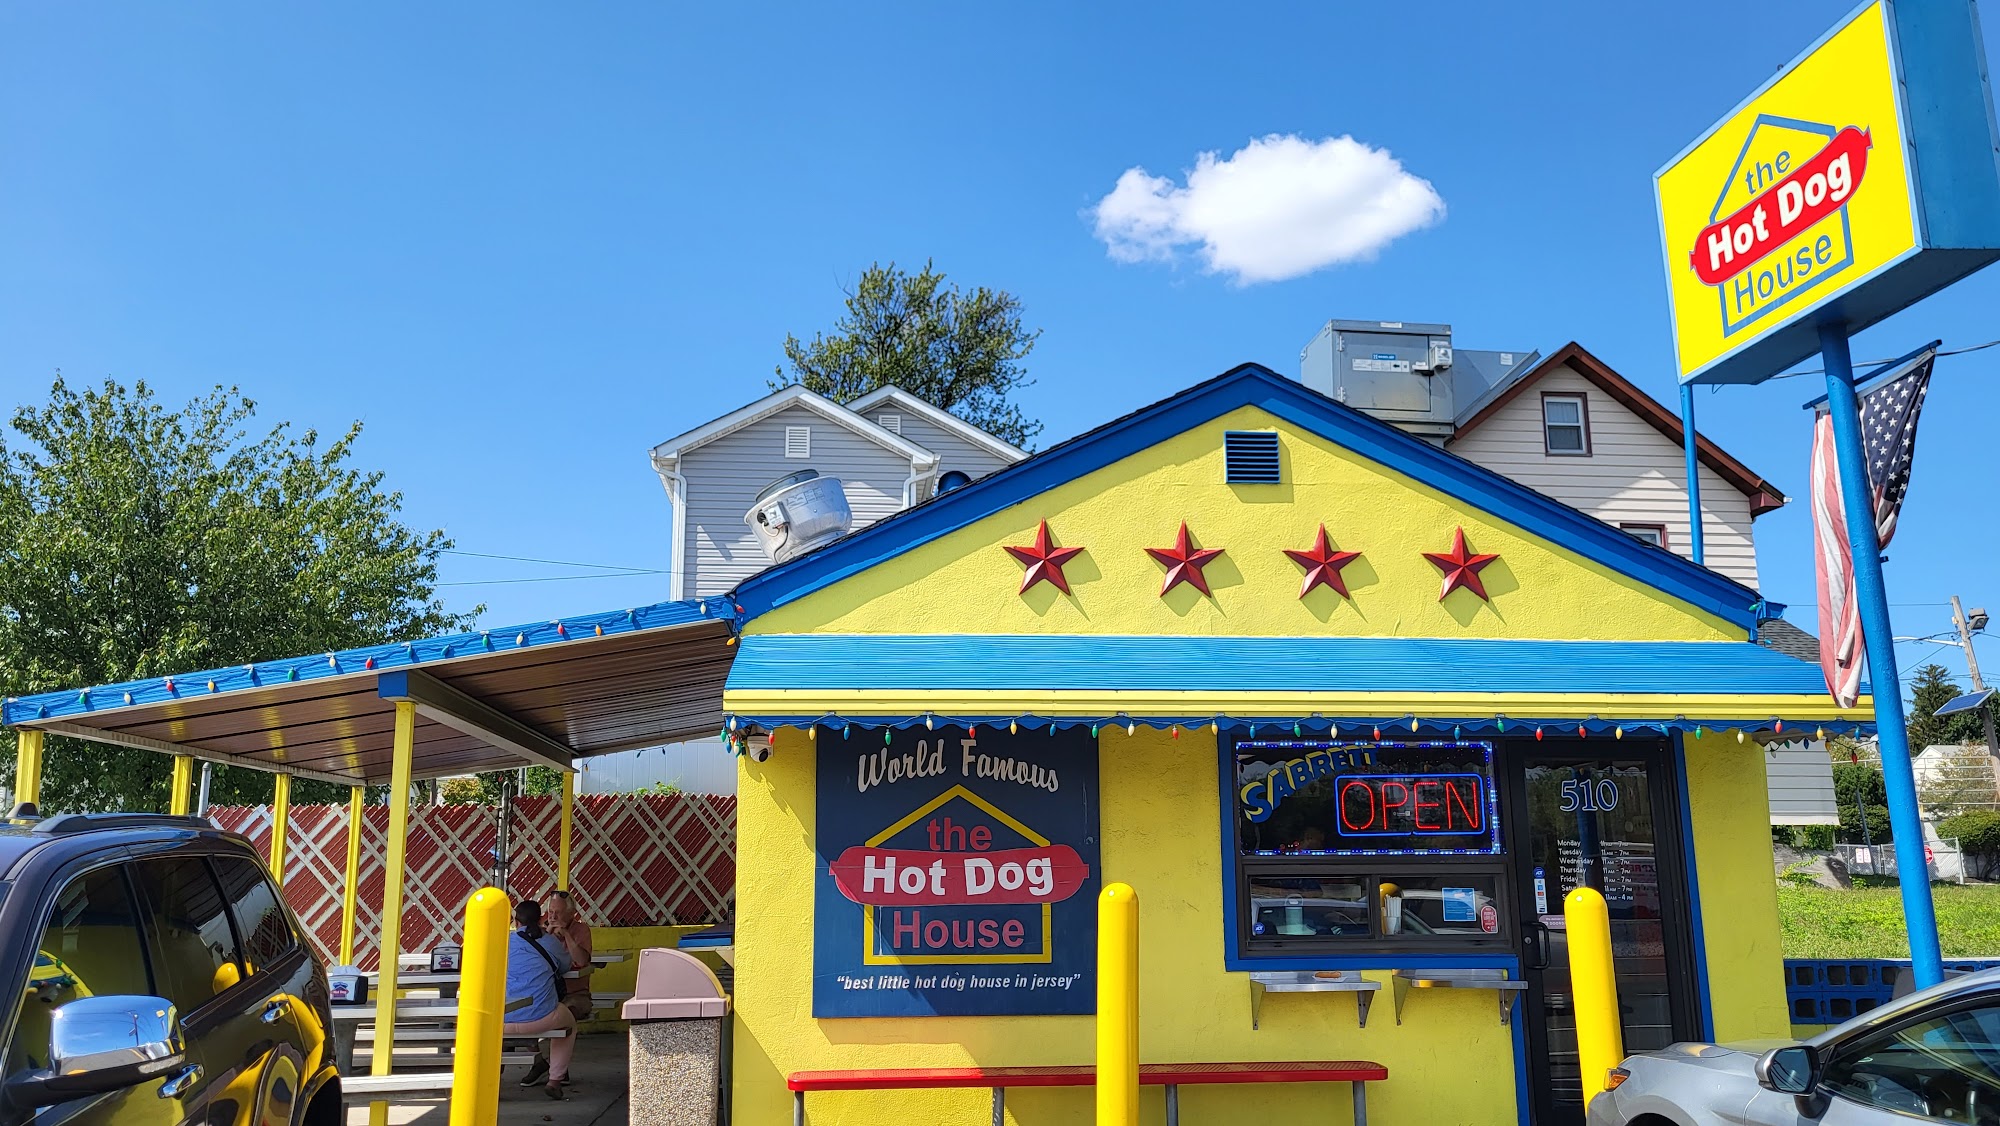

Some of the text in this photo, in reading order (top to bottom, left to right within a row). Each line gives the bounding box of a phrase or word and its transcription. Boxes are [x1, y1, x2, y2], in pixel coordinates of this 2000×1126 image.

[1745, 150, 1791, 195] the
[1707, 151, 1853, 271] Hot Dog
[1734, 234, 1832, 314] House
[857, 739, 1059, 793] World Famous
[1240, 744, 1379, 823] SABRETT
[1341, 781, 1479, 830] OPEN
[1559, 778, 1619, 812] 510
[926, 817, 992, 851] the
[1558, 848, 1583, 857] Tuesday
[863, 856, 1054, 896] Hot Dog
[893, 910, 1025, 948] House
[878, 975, 910, 990] little
[915, 975, 937, 989] hot
[941, 974, 965, 991] dog
[970, 974, 1010, 988] house
[1015, 974, 1027, 987] in
